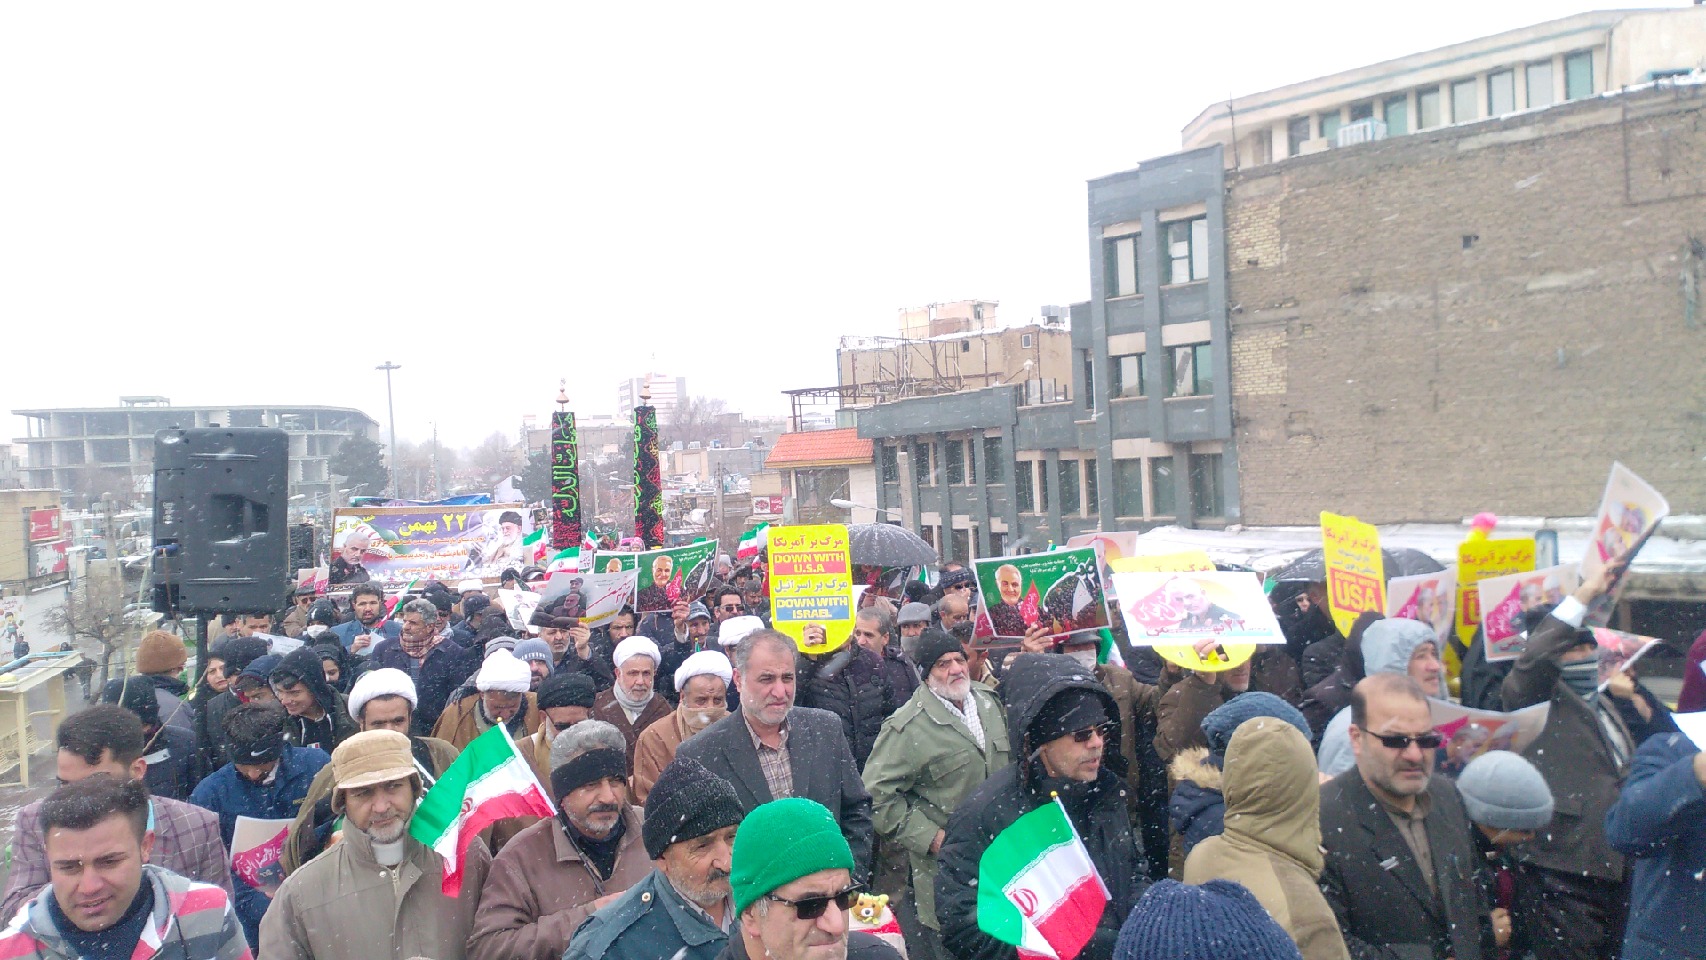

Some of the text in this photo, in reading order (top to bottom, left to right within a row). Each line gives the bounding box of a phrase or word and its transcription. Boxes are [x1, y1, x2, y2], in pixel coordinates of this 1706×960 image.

[398, 519, 438, 537] بهمن
[442, 512, 467, 532] ۲۲
[773, 535, 844, 549] مرگ بر آمریکا
[774, 552, 844, 563] DOWN WITH
[793, 563, 825, 573] U.S.A
[774, 579, 848, 593] مرگ بر اسرائیل
[776, 597, 848, 608] DOWN WITH
[1335, 580, 1379, 613] USA
[792, 609, 833, 619] ISRAEL
[1223, 619, 1246, 632] ۲۲
